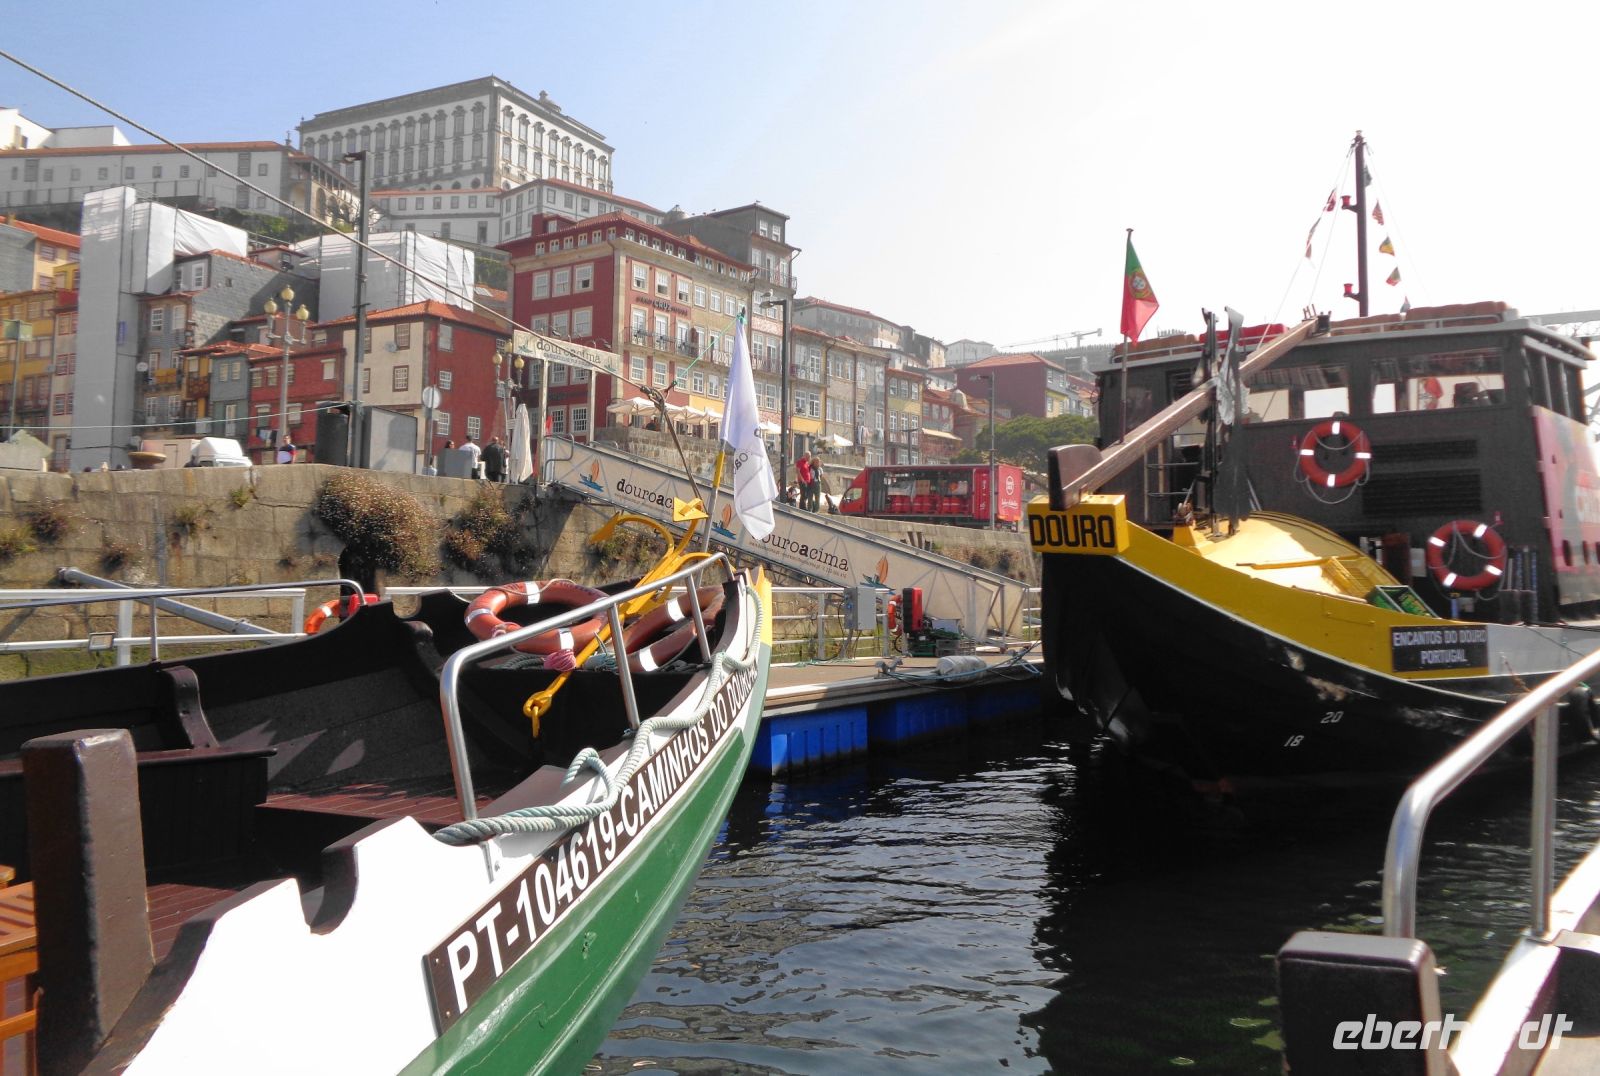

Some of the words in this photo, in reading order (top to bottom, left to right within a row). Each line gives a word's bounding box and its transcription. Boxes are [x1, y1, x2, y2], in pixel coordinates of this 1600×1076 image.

[616, 478, 674, 509] douroac
[1029, 513, 1115, 549] DOURO
[751, 532, 849, 572] ouroacima
[1392, 630, 1442, 647] ENCANTOS
[1444, 630, 1458, 644] DO
[1459, 629, 1488, 643] DOURO
[1420, 648, 1468, 665] PORTUGAL
[709, 692, 728, 740] DO
[1320, 710, 1345, 724] 20
[1283, 734, 1305, 748] 18
